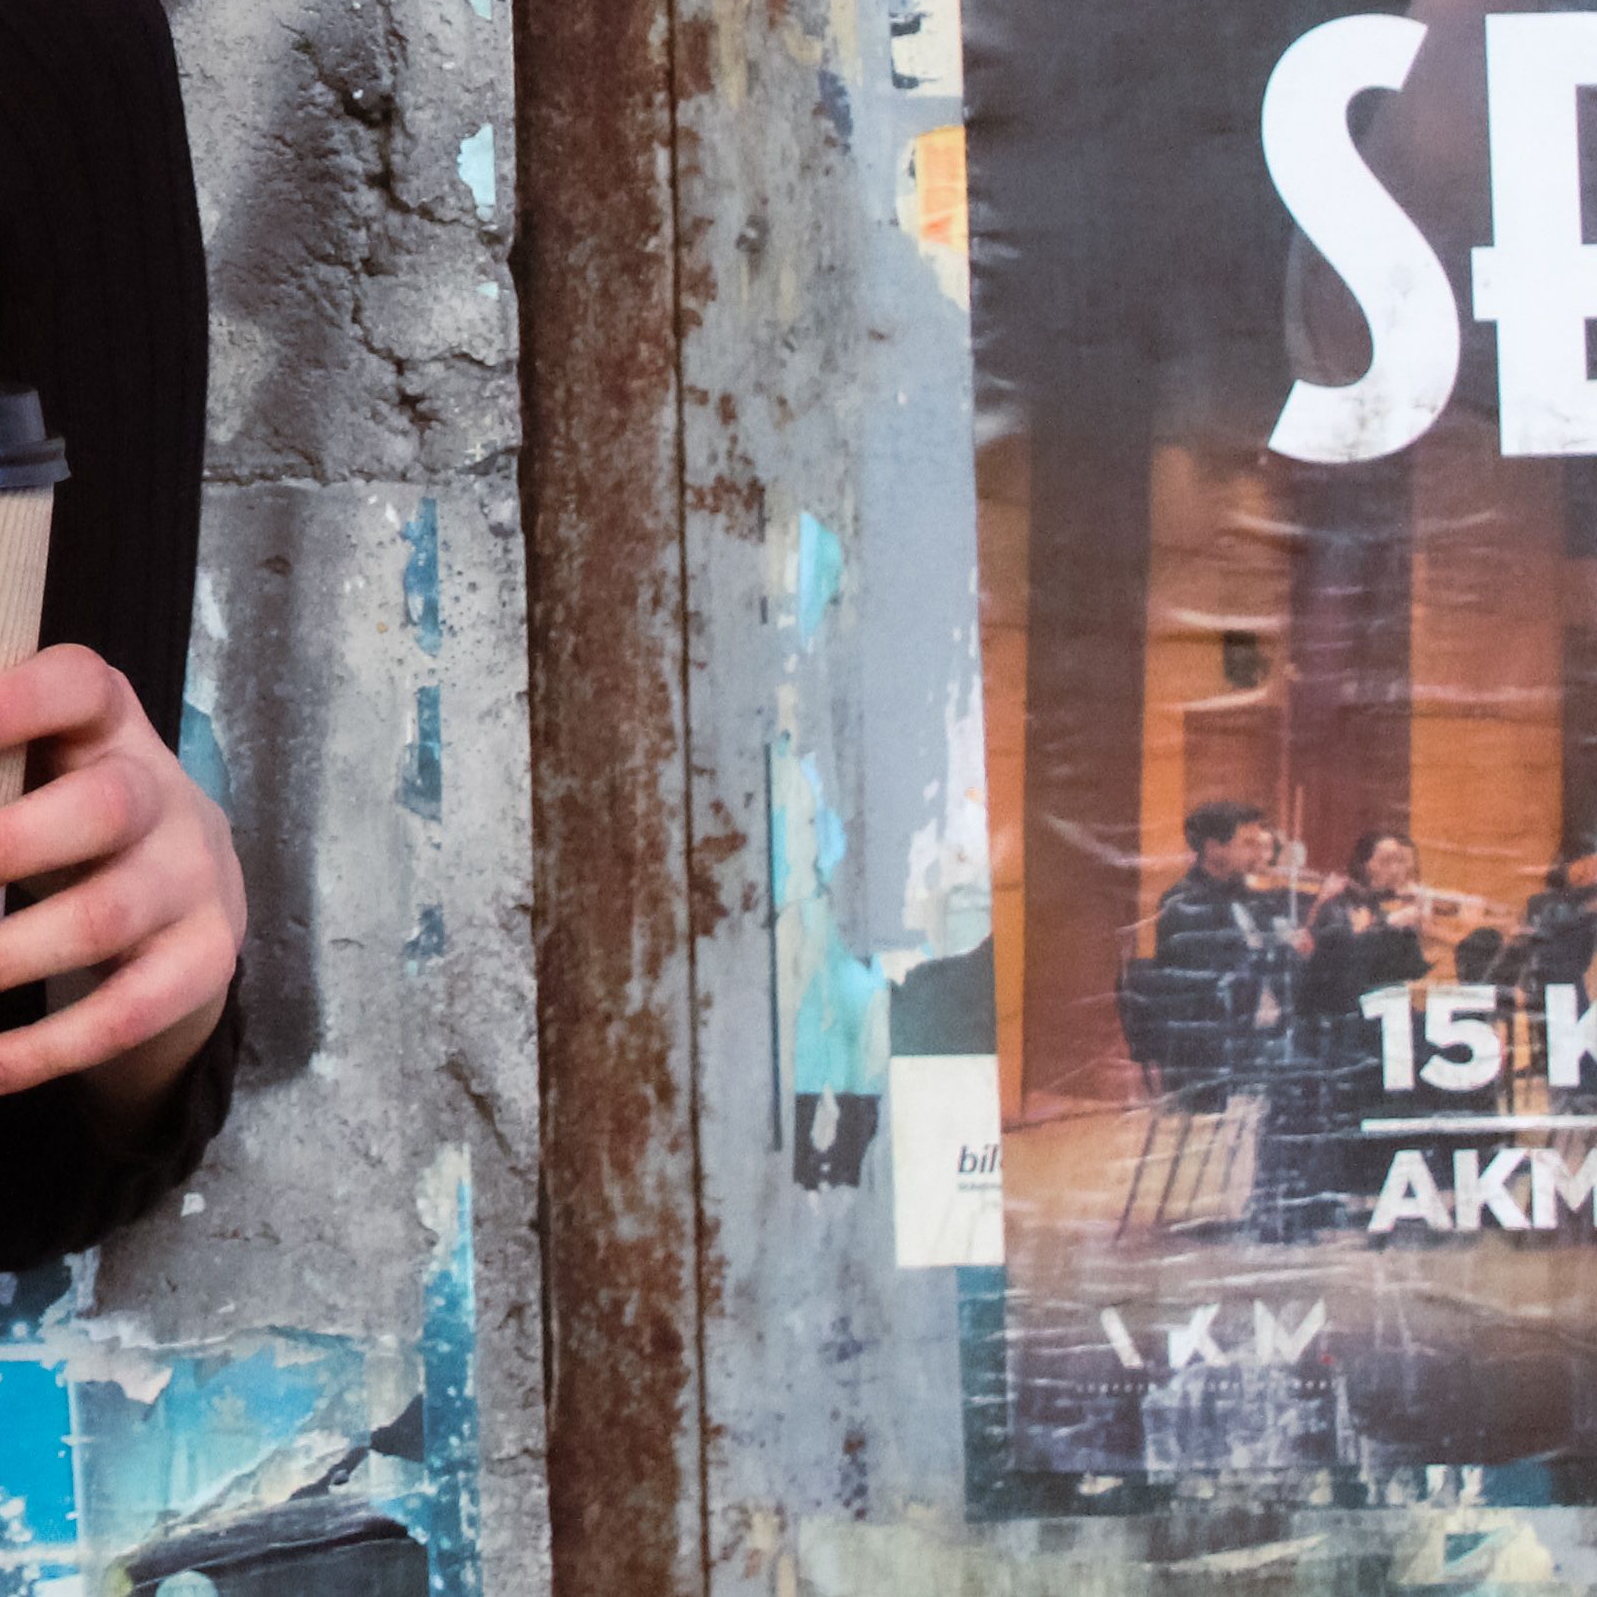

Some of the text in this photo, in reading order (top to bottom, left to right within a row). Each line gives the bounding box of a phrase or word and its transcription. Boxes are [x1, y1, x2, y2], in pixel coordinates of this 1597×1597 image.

[1359, 983, 1504, 1092] 15
[957, 1143, 1003, 1174] bil
[1367, 1148, 1597, 1233] AKM
